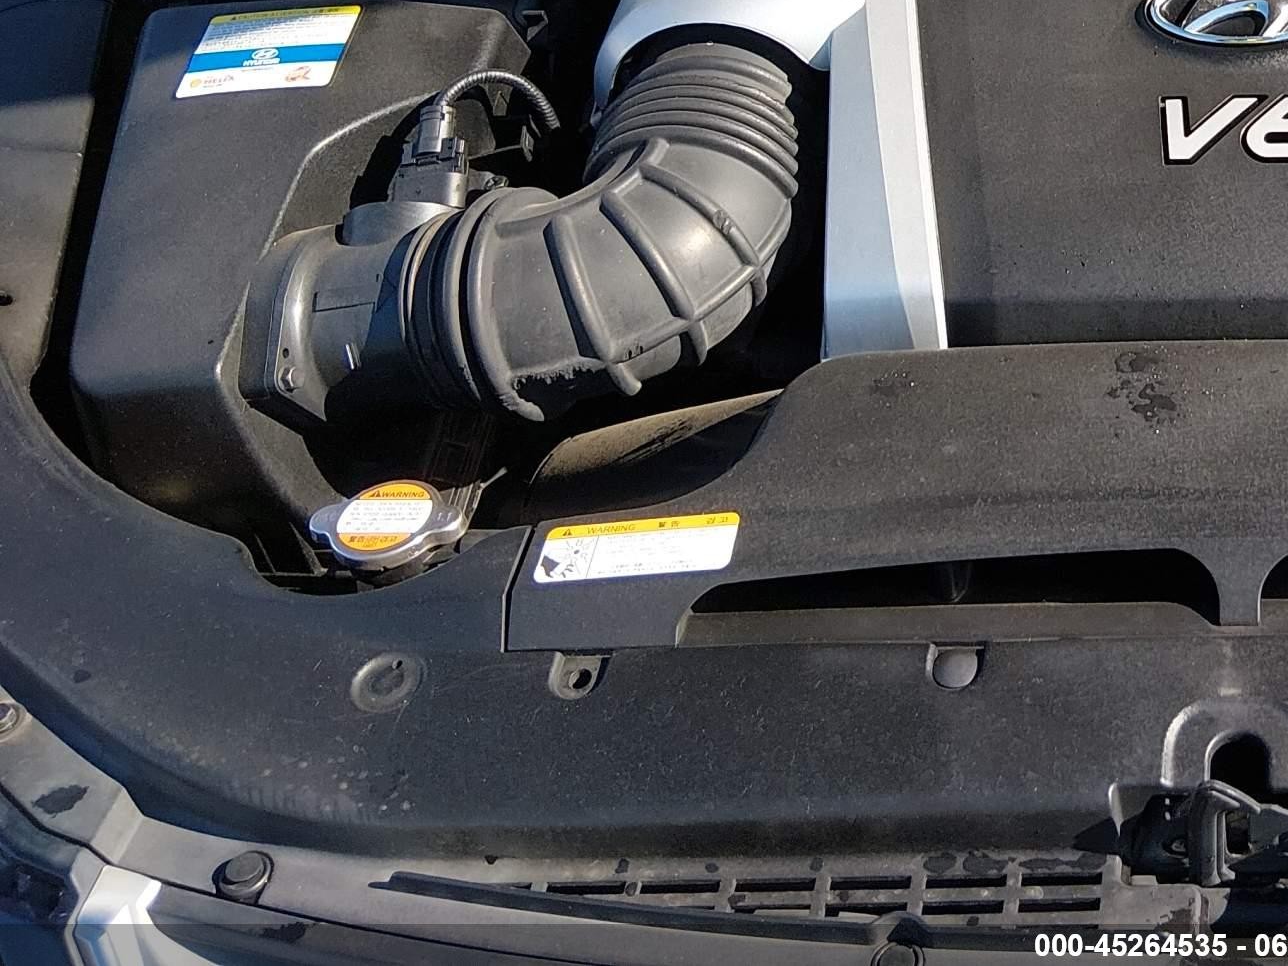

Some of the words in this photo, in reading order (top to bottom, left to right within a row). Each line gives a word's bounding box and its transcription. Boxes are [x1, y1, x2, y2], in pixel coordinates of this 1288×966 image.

[243, 57, 280, 67] HYUNDAI
[381, 490, 426, 499] WARNING
[587, 523, 636, 535] WARNING
